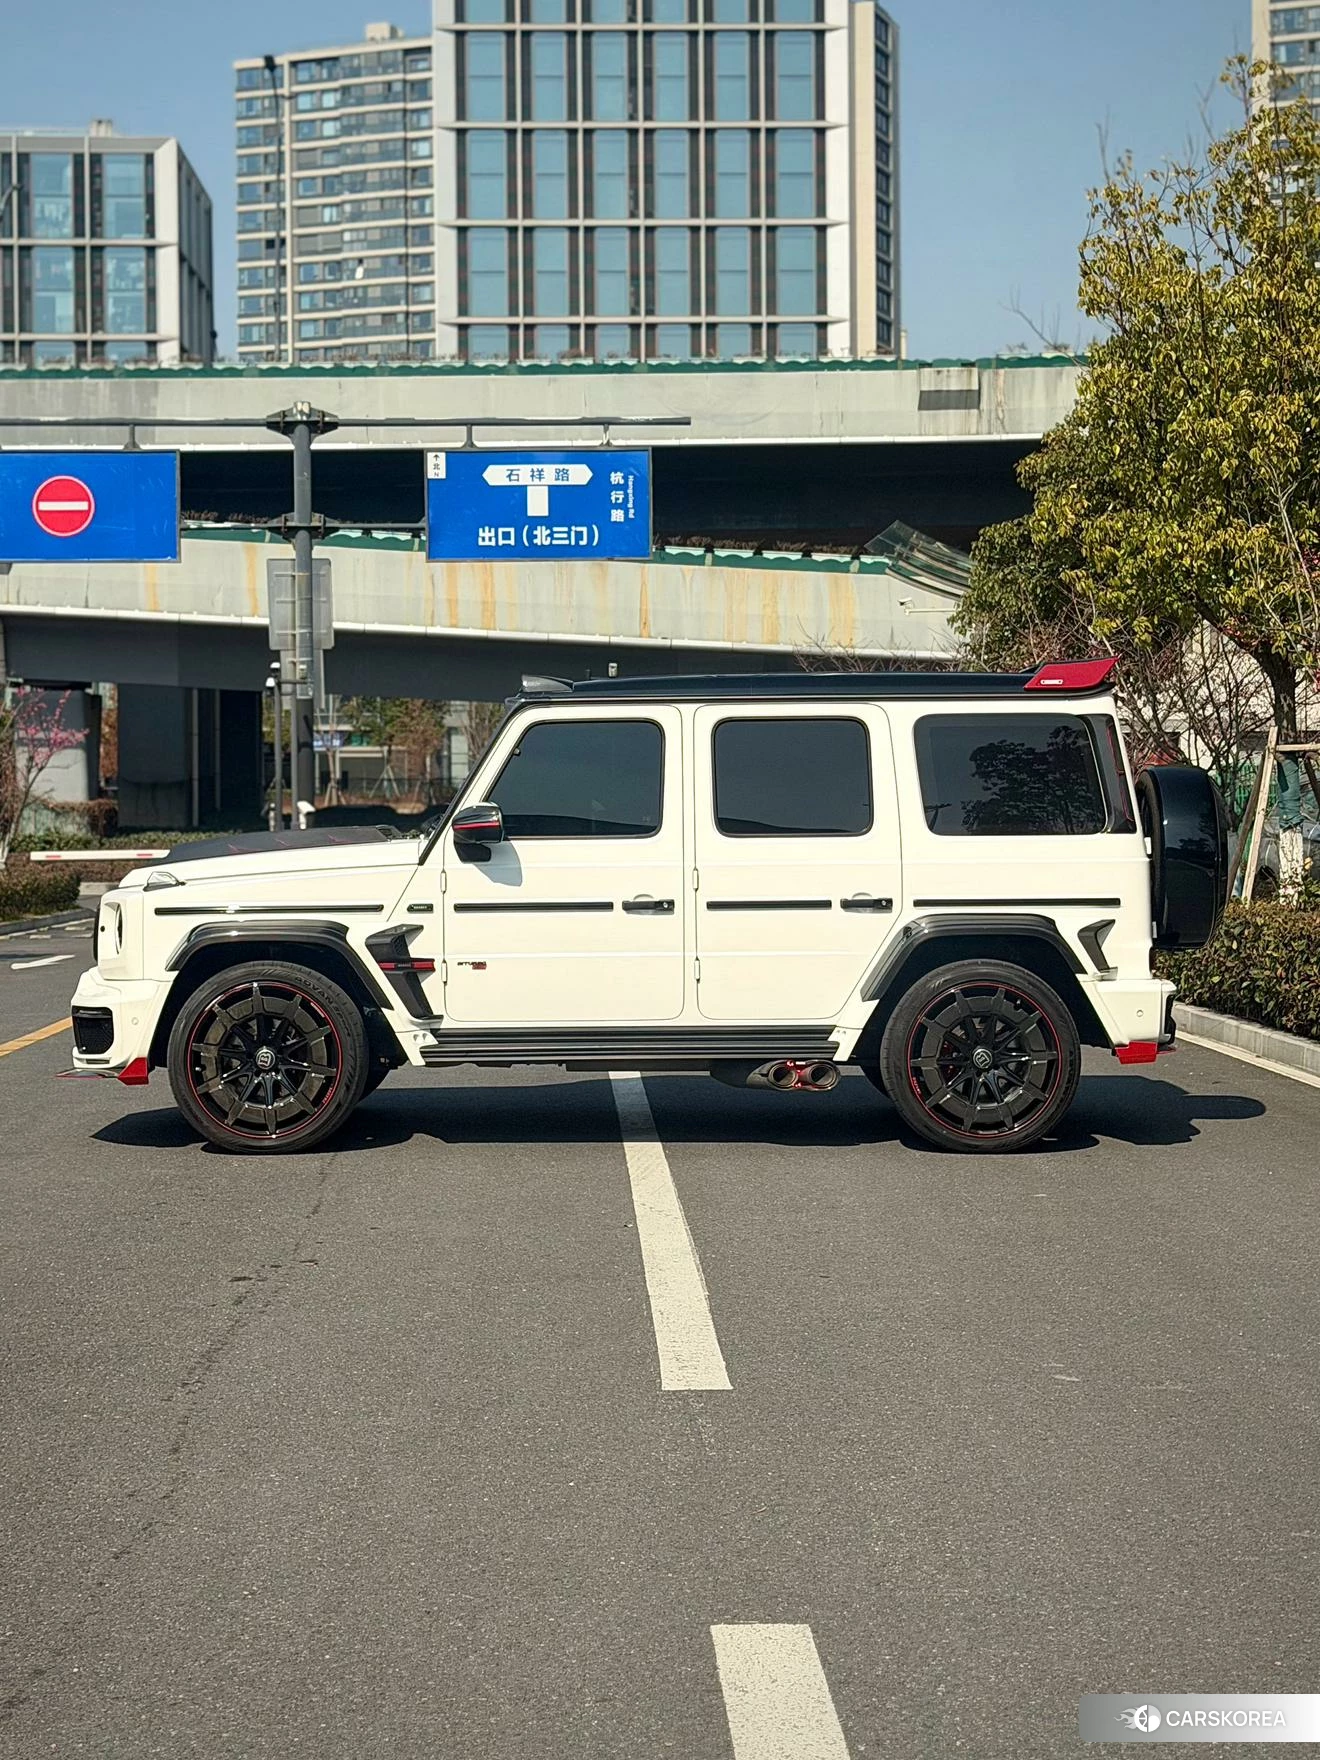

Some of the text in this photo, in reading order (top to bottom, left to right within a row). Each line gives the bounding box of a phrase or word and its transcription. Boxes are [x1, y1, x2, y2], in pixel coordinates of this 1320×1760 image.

[505, 468, 570, 482] 石祥路
[610, 471, 625, 522] 杭行路
[628, 508, 635, 519] Rd
